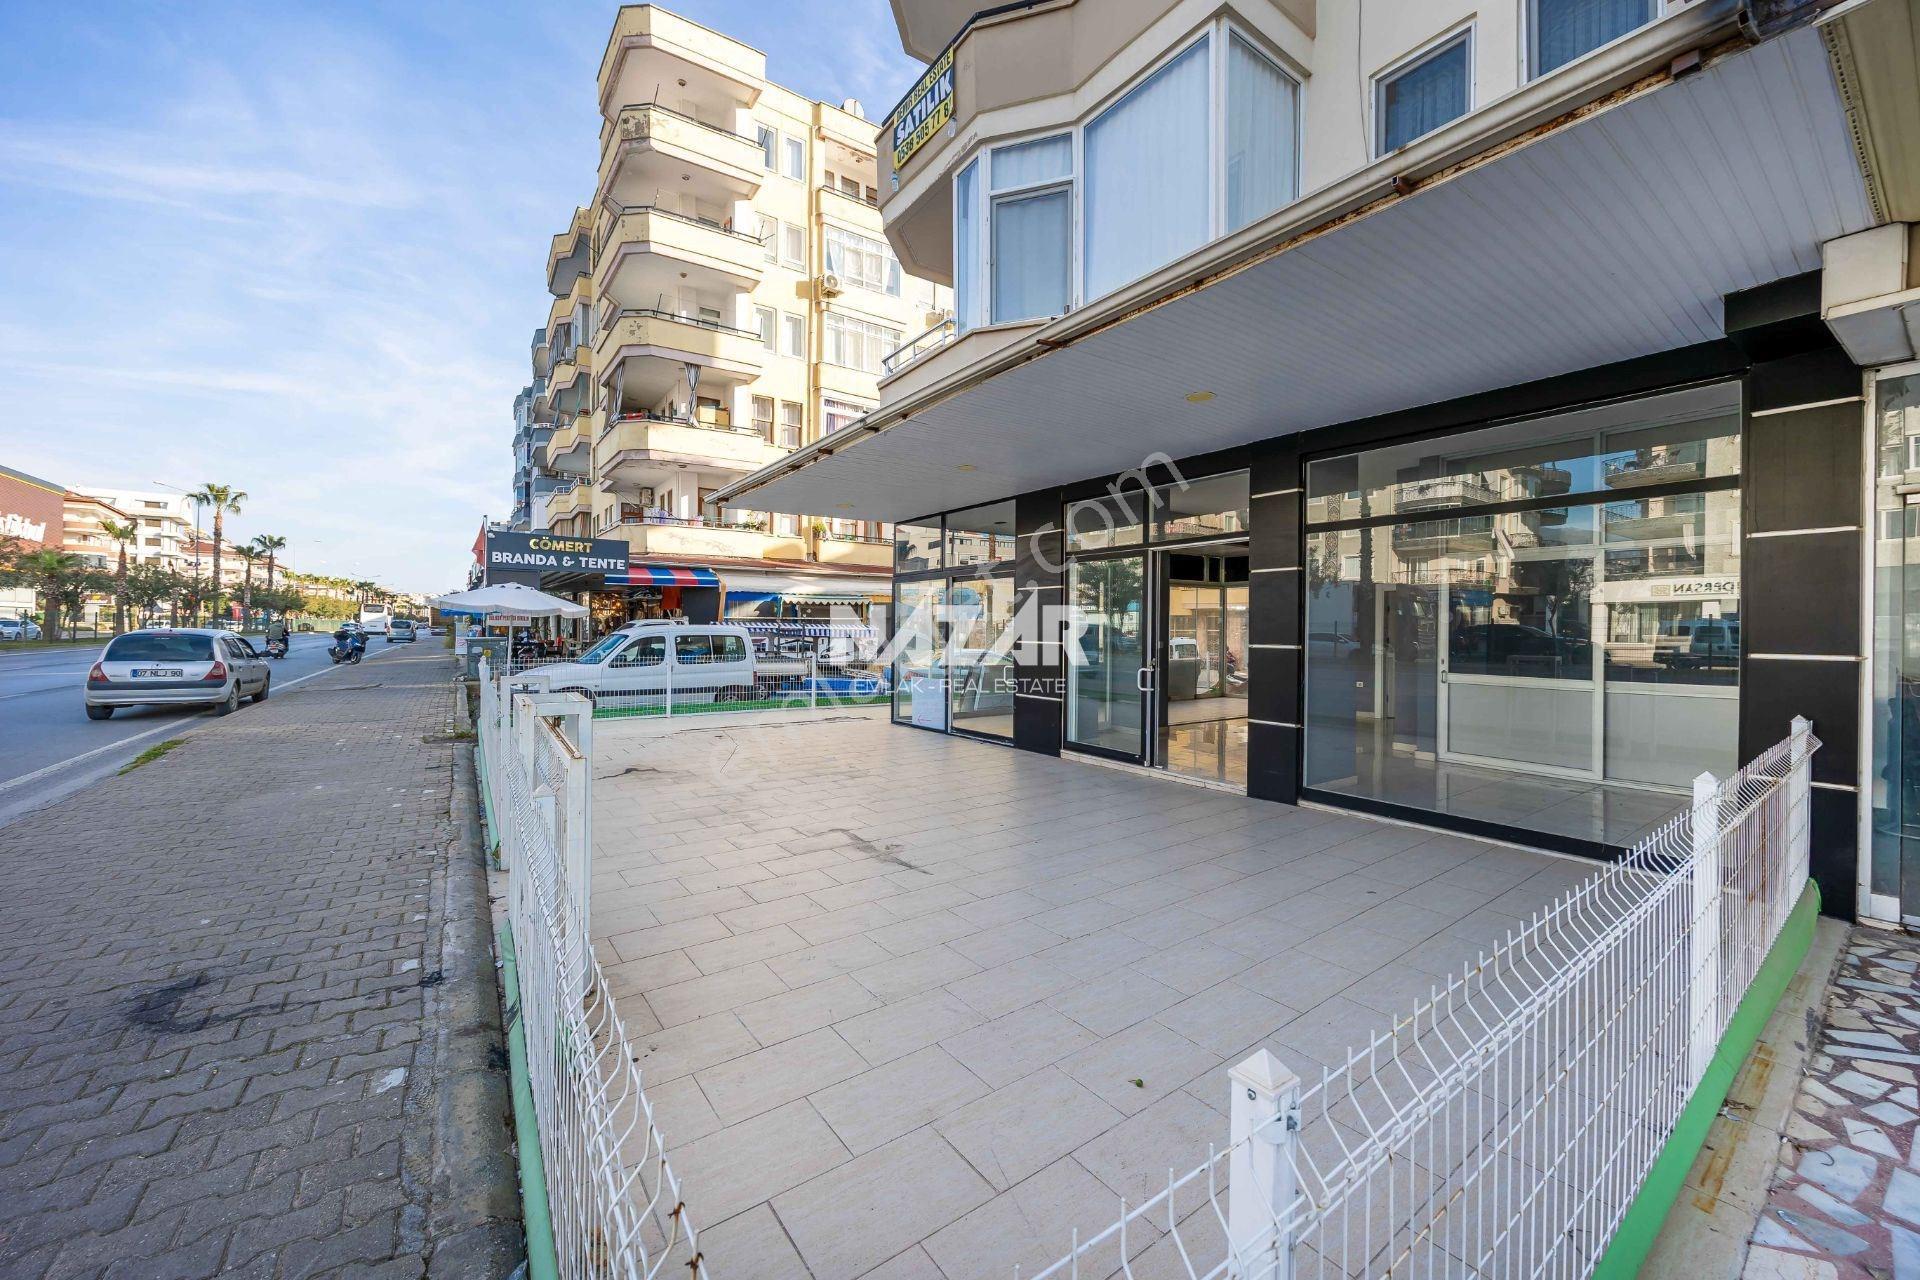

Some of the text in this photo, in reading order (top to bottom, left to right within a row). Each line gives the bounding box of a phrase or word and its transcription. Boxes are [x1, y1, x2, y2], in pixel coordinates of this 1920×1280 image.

[913, 79, 928, 102] REAL
[929, 50, 951, 87] ESTATE
[896, 70, 952, 146] SATILIK
[916, 122, 929, 145] 505
[529, 536, 593, 553] CÖMERT
[491, 552, 626, 570] BRANDA & TENTE
